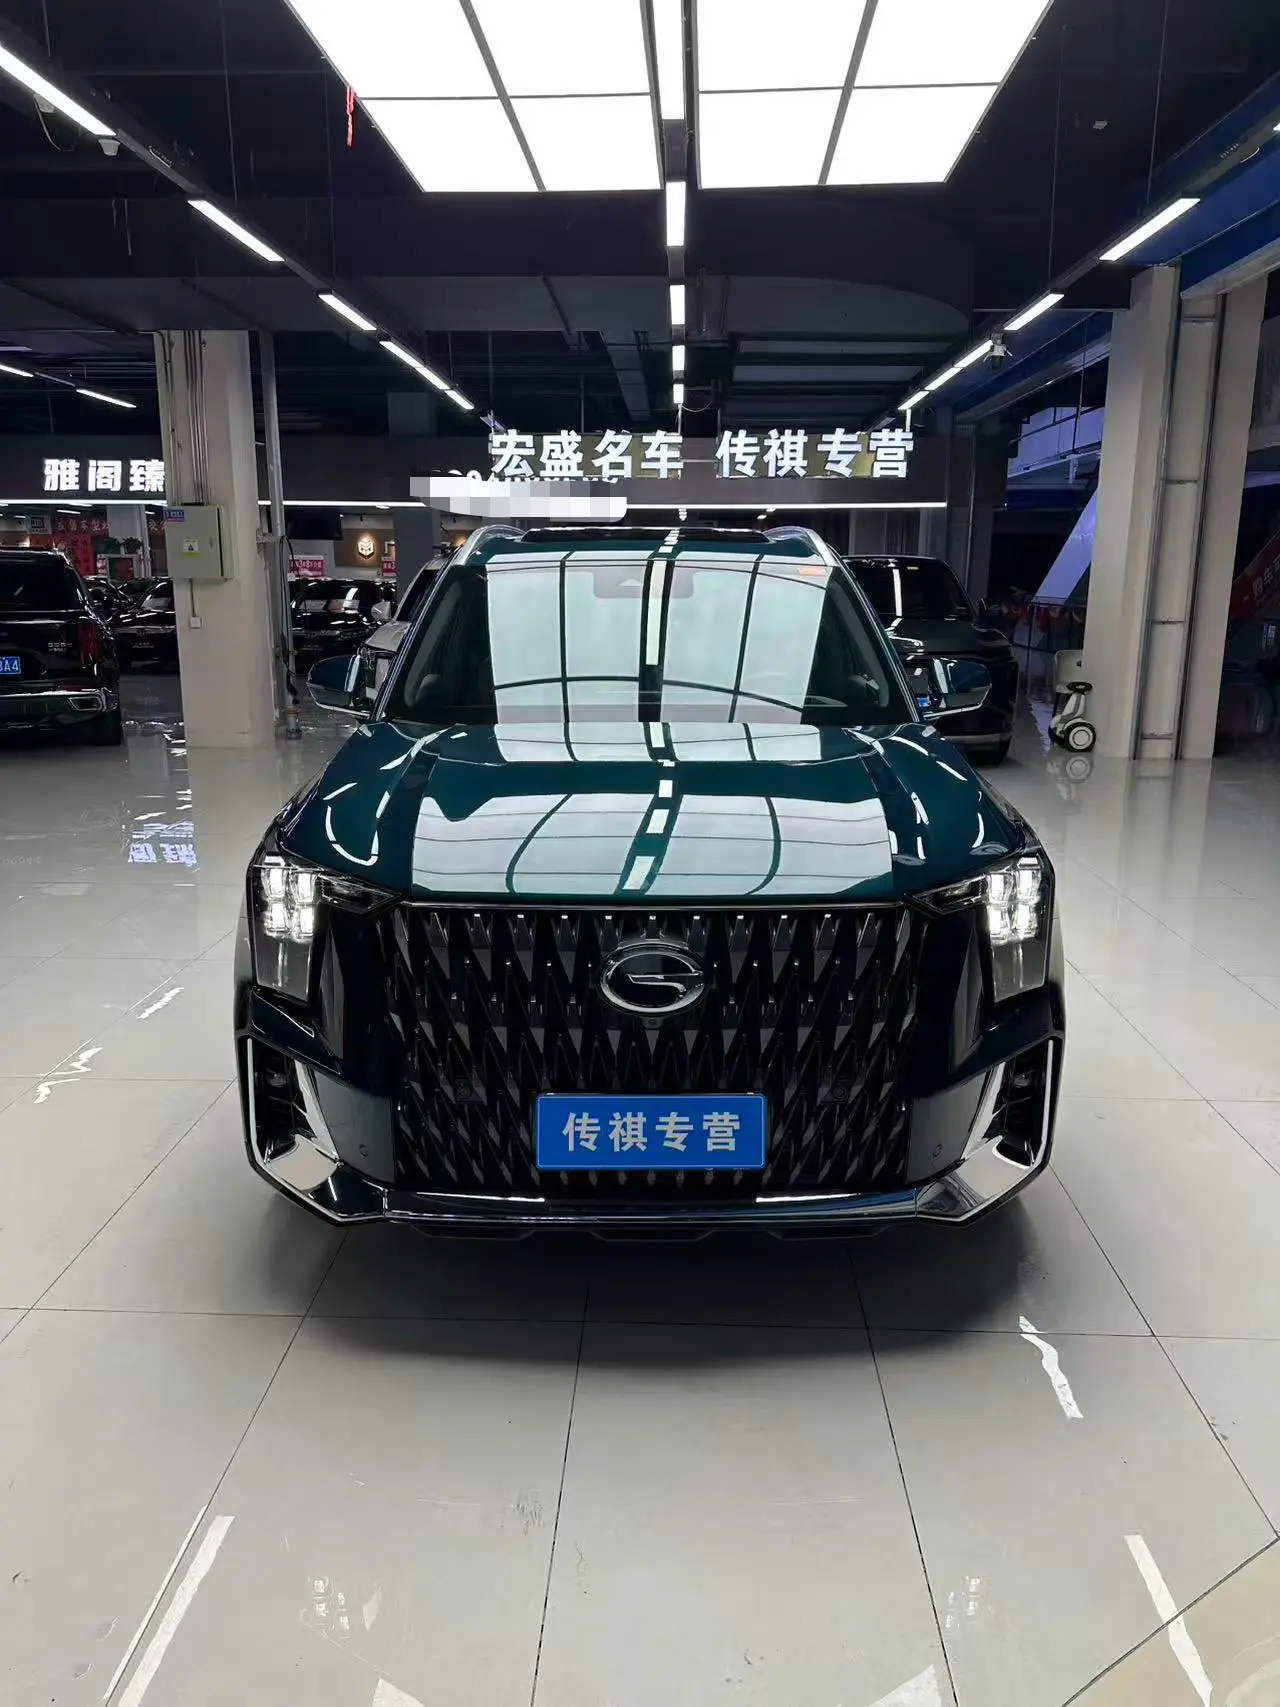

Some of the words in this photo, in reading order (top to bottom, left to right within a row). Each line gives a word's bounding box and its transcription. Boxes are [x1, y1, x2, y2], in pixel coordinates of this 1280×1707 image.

[490, 428, 684, 479] 宏盛名车
[715, 427, 914, 478] 传祺专营
[43, 458, 165, 491] 雅阁臻
[562, 1111, 740, 1152] 传祺专营
